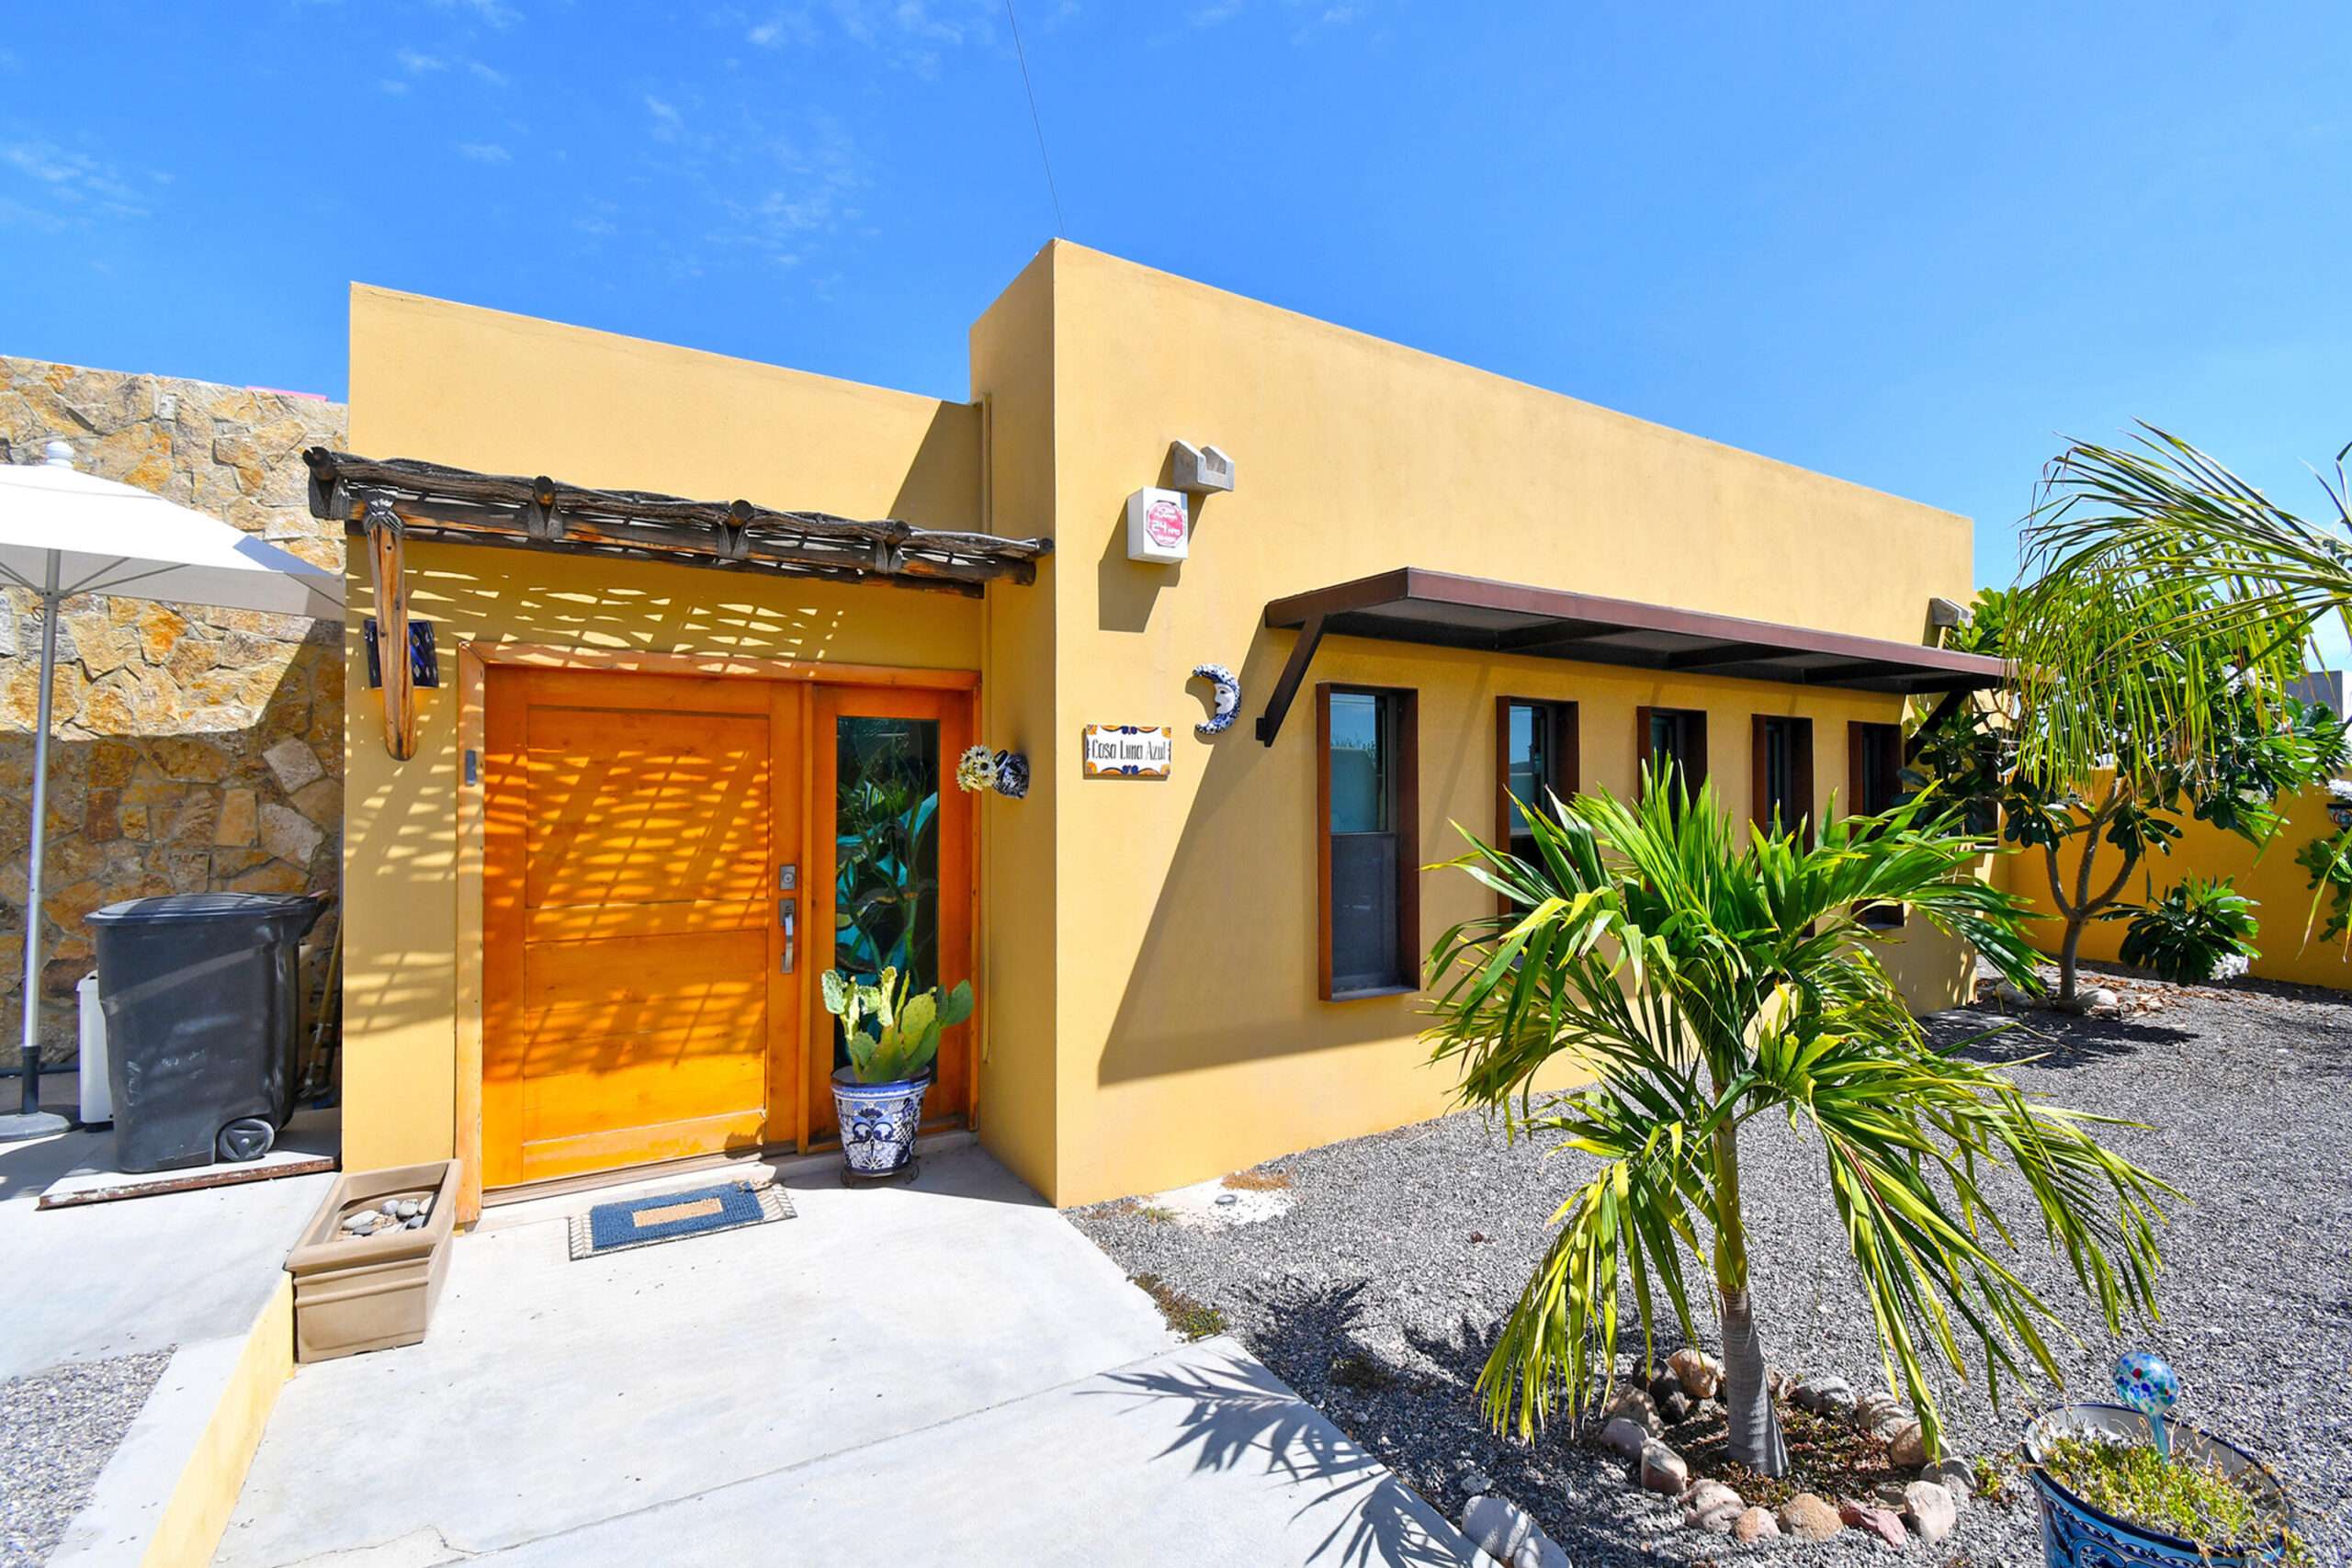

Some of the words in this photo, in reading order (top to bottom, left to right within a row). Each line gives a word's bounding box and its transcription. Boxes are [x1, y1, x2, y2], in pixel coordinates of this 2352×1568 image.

[1091, 739, 1116, 759] Casa
[1120, 739, 1143, 760] Luna
[1145, 740, 1166, 761] Azul
